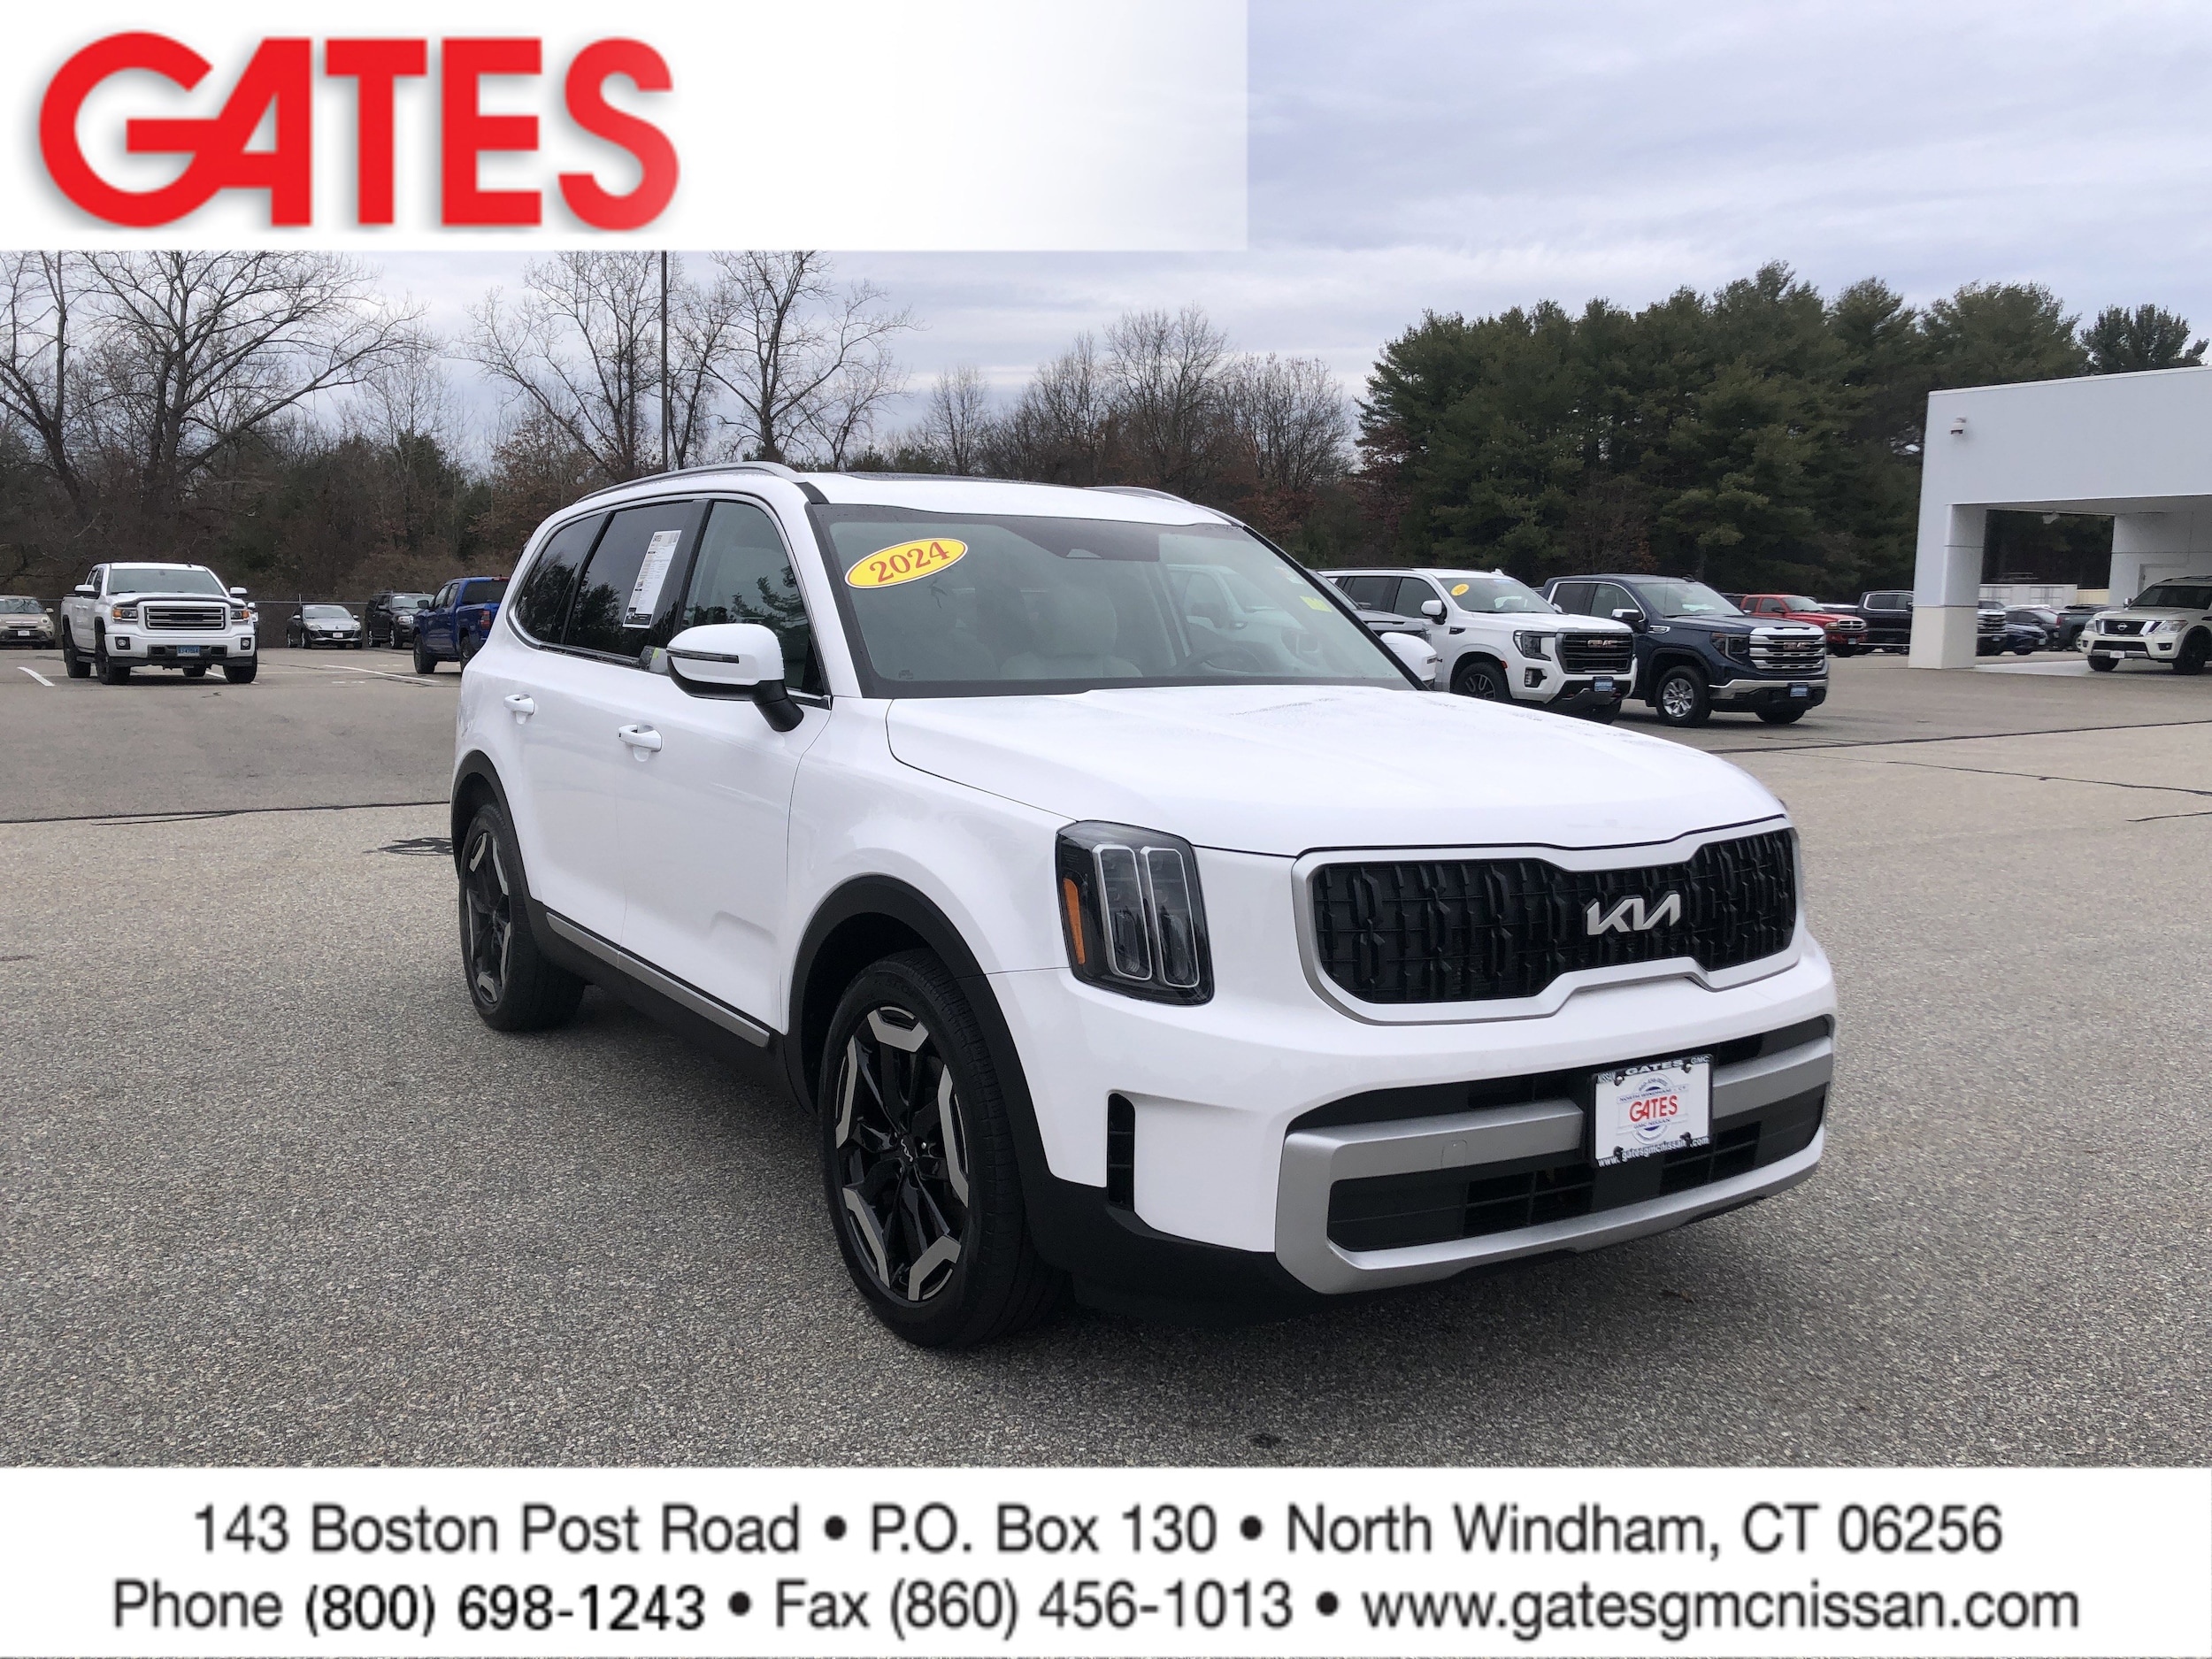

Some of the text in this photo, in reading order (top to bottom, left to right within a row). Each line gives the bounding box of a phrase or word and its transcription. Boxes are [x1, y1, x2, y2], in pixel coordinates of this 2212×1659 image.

[869, 541, 951, 583] 2024
[1586, 892, 1681, 936] KIA
[1625, 1056, 1709, 1076] GATES GMC
[1630, 1094, 1678, 1122] GATES
